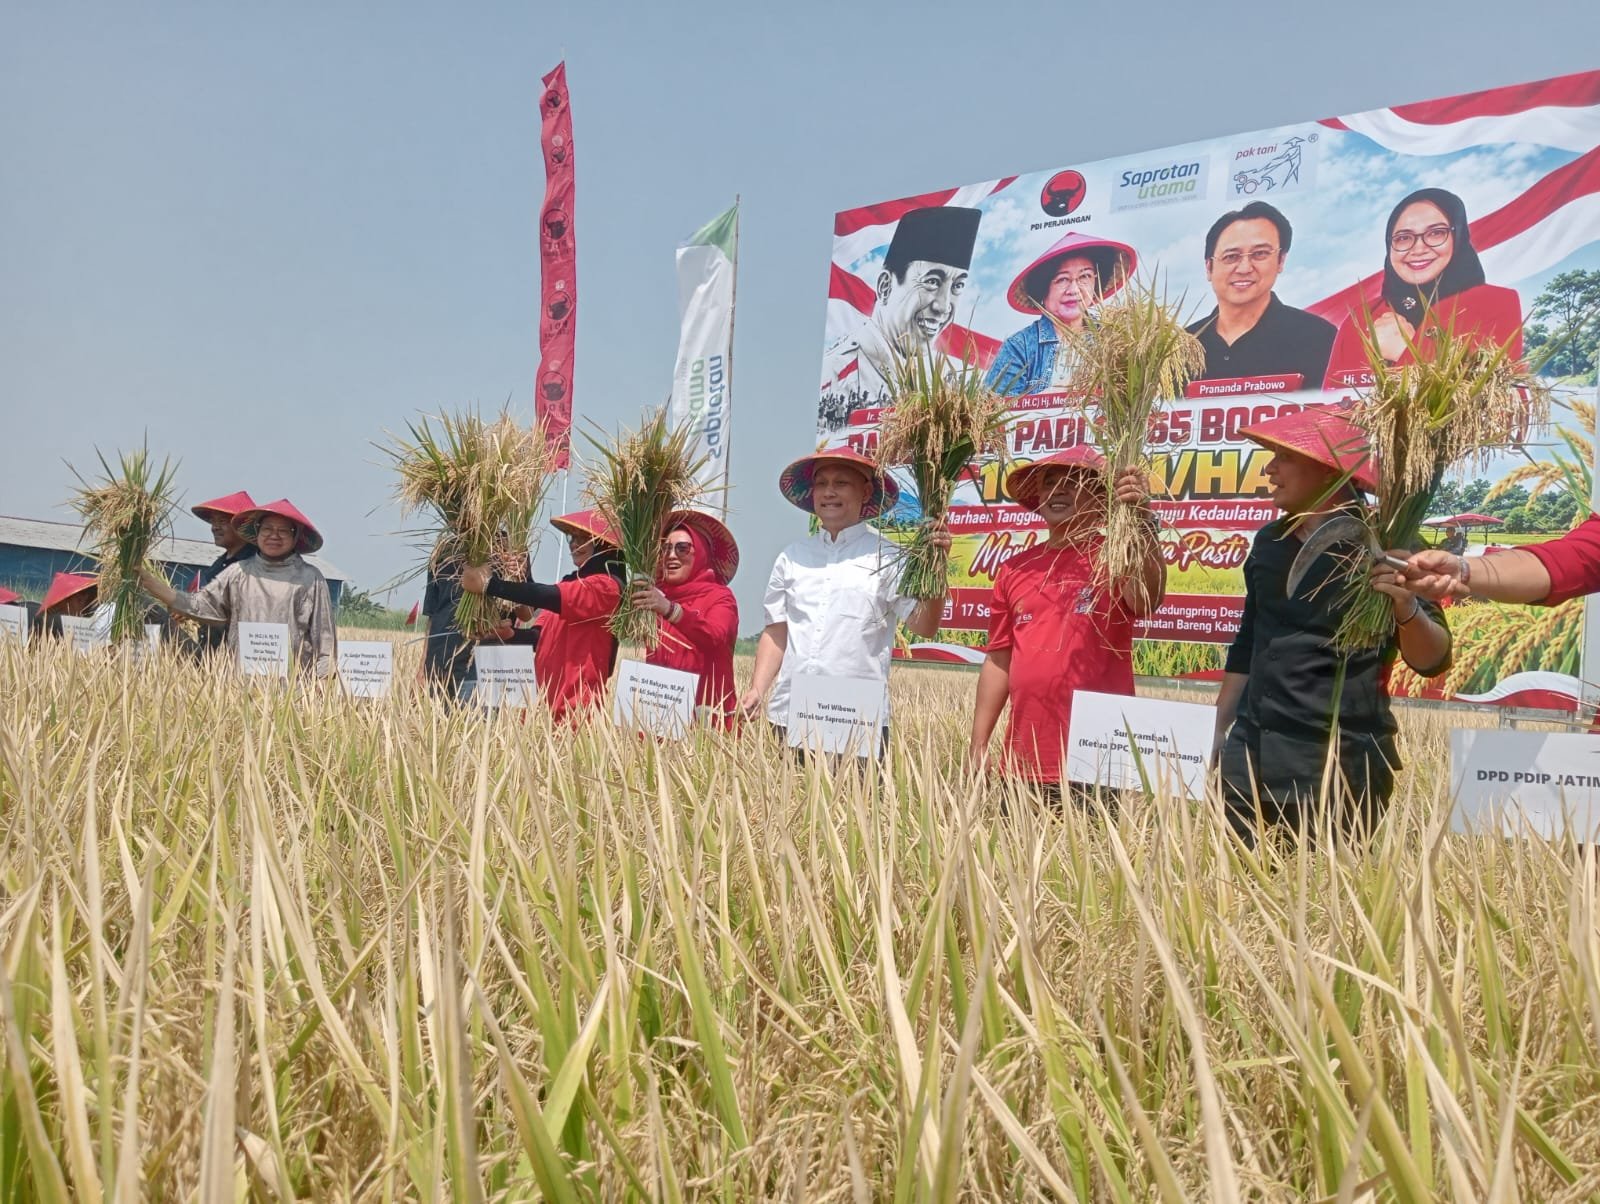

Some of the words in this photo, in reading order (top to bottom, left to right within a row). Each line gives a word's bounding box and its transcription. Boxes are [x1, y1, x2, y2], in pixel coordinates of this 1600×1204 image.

[1235, 145, 1256, 161] pak
[1256, 143, 1278, 156] tani
[1120, 162, 1200, 188] Saprotan
[1137, 178, 1197, 200] utama
[1030, 223, 1043, 231] PDI
[1043, 214, 1092, 229] PERJUANGAN
[1199, 383, 1243, 395] Prananda
[1243, 380, 1286, 392] Prabowo
[1013, 414, 1087, 452] PADI
[947, 509, 993, 525] Marhaen
[997, 509, 1047, 526] Tanggun
[1188, 505, 1273, 521] Kedaulatan
[1181, 532, 1247, 568] Pasti
[961, 603, 974, 617] 17
[976, 604, 991, 618] Se
[1155, 604, 1218, 619] Kedungpring
[1133, 618, 1174, 630] camatan
[1176, 618, 1212, 634] Bareng
[1214, 620, 1241, 633] Kabu
[1110, 741, 1129, 752] DPC
[1476, 769, 1509, 782] DPD
[1513, 771, 1551, 785] PDIP
